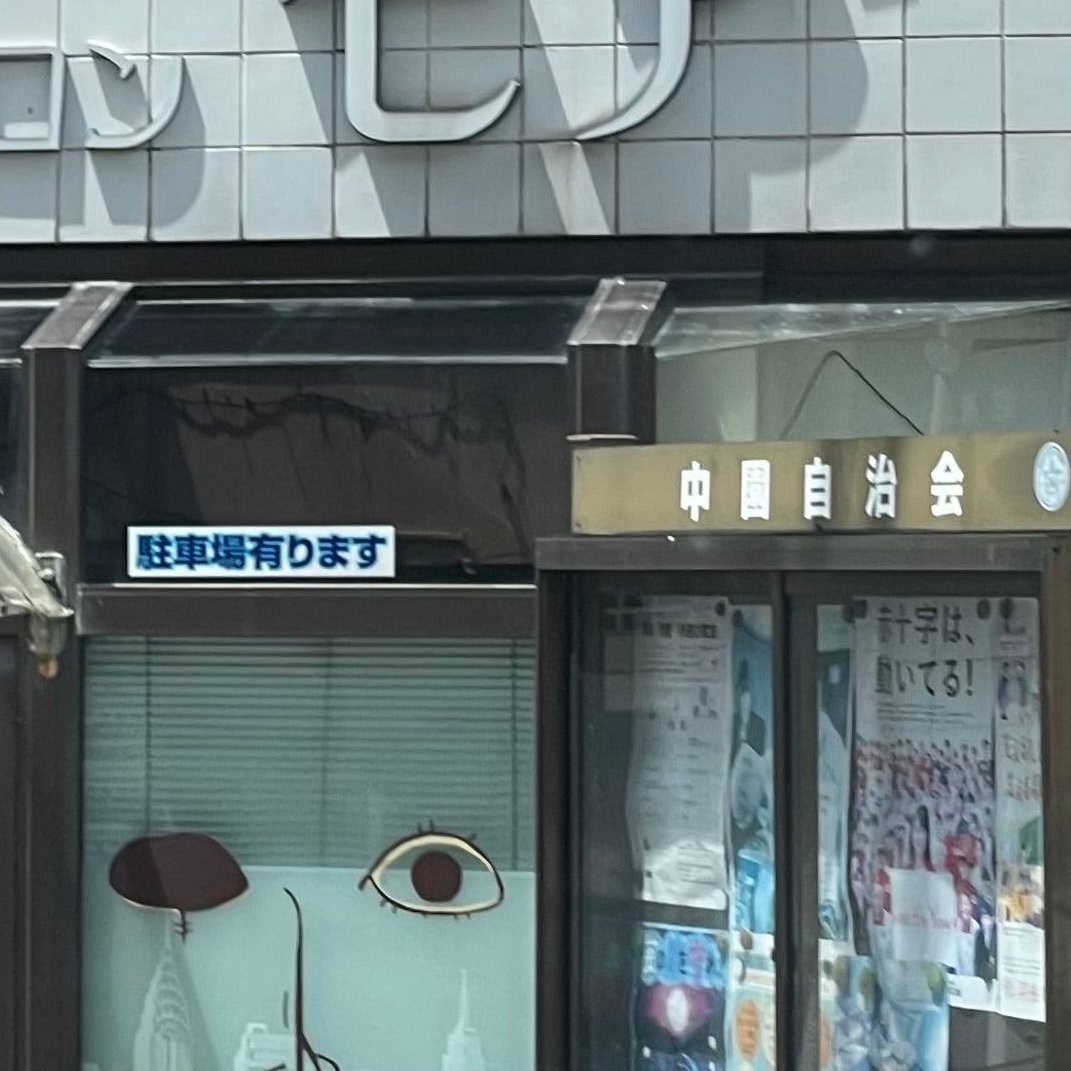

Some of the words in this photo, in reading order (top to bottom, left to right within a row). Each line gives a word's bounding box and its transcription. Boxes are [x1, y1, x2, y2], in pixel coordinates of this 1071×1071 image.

[136, 533, 388, 571] 駐車場有ります
